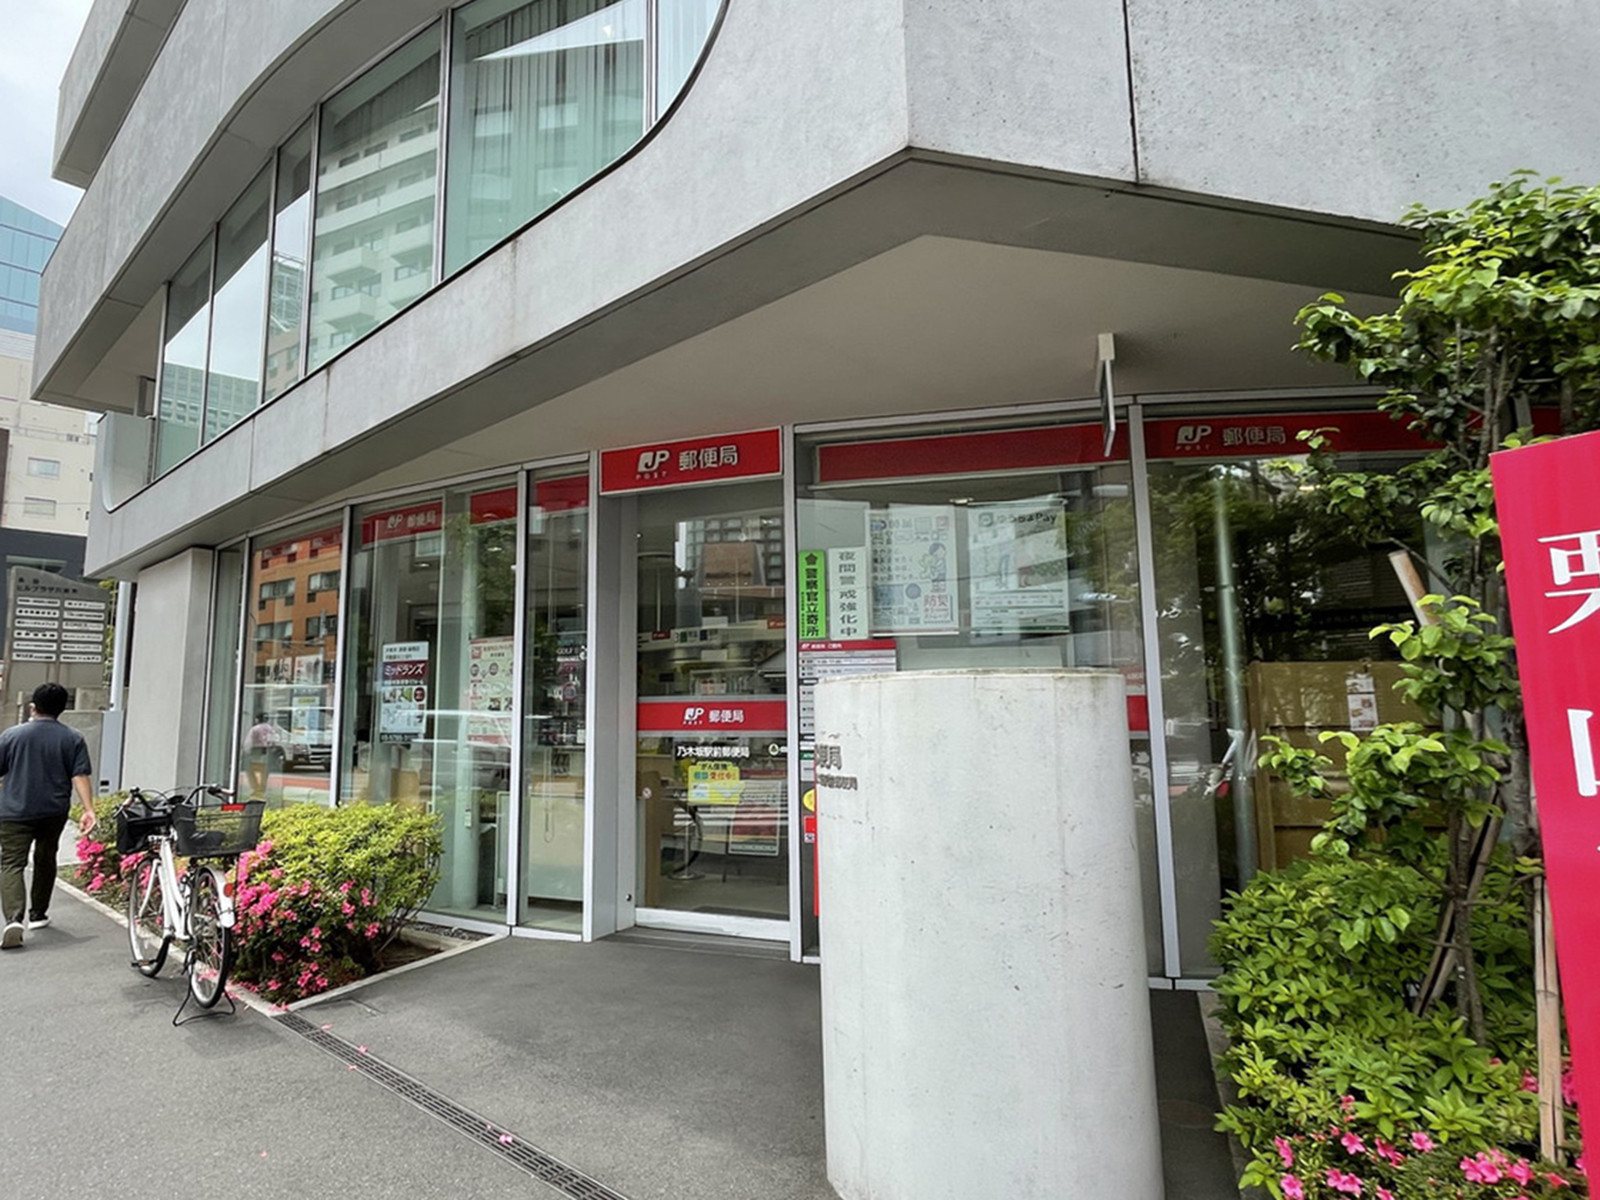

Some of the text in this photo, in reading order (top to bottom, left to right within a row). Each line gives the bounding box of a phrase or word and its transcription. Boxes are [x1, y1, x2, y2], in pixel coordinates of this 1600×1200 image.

[1222, 426, 1286, 447] 郵便局
[678, 444, 738, 471] 郵便局
[635, 471, 668, 480] POST
[805, 568, 819, 637] 警察官立寄所
[838, 551, 858, 637] 夜間警戒強化中
[708, 709, 744, 723] 郵便局
[676, 745, 750, 758] 乃木坂駅前郵便局
